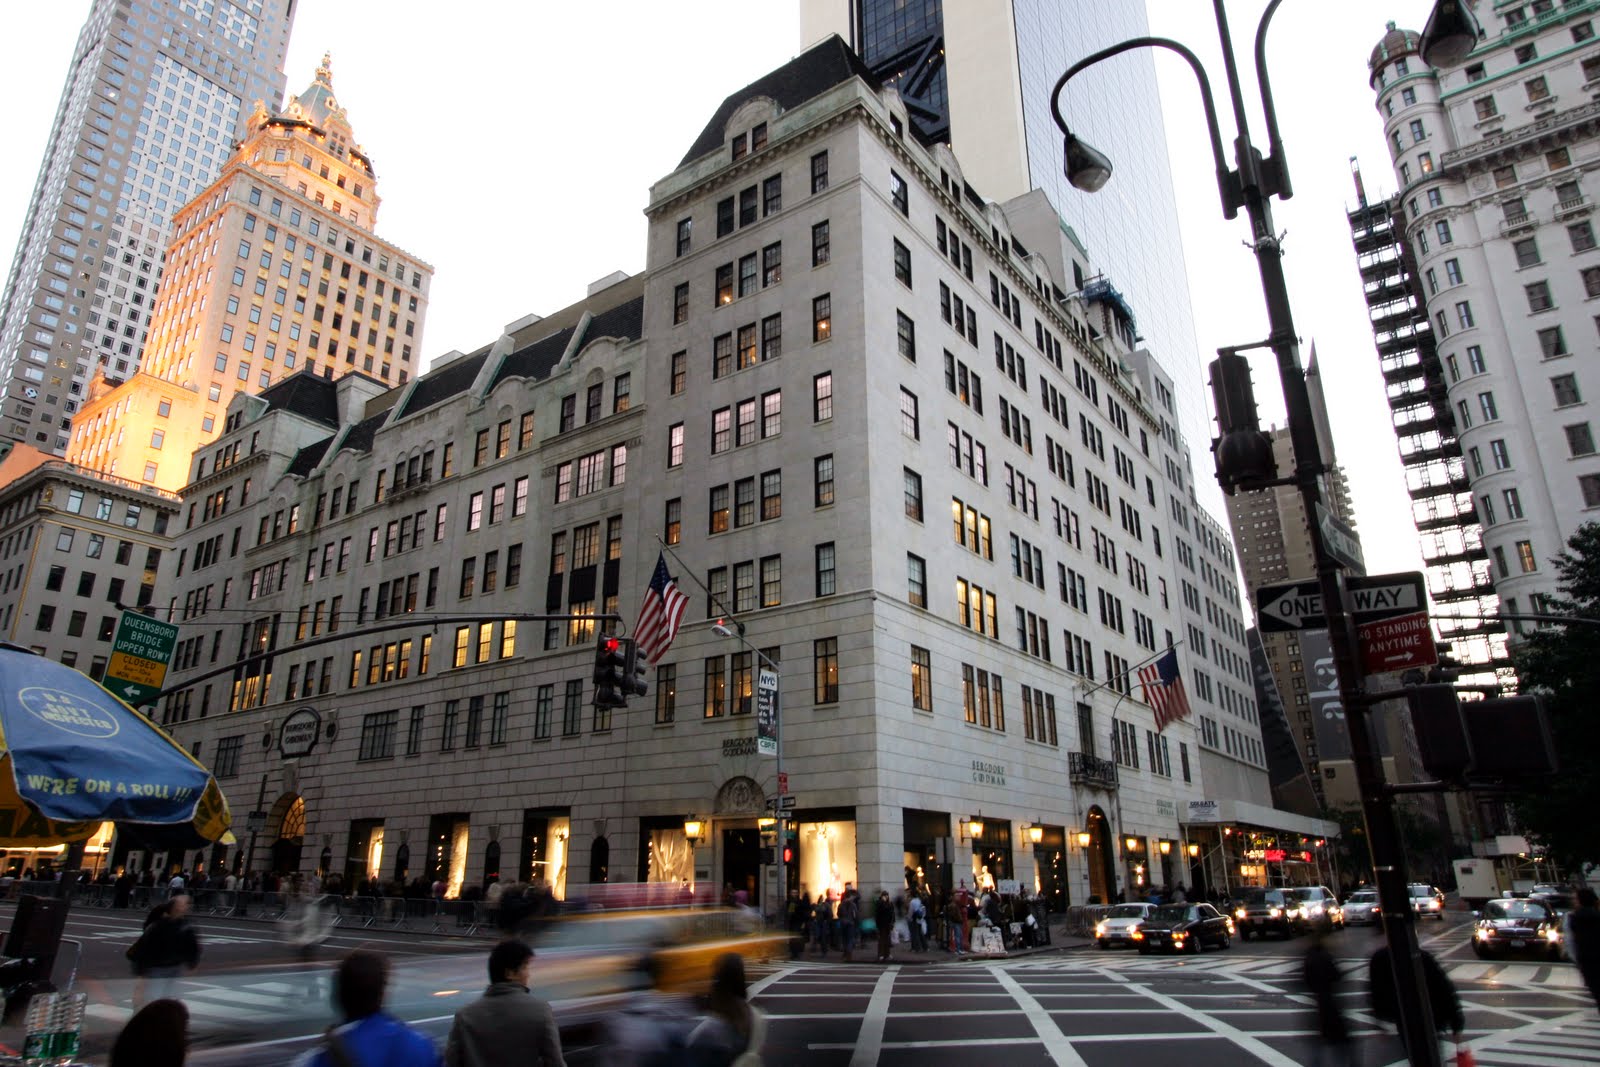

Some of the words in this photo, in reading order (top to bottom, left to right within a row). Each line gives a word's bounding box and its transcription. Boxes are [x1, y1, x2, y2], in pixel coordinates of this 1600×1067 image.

[1279, 597, 1322, 617] ONE
[1354, 588, 1402, 610] WAY
[124, 616, 175, 639] QUEENSBORO
[1376, 618, 1426, 638] STANDING
[130, 631, 163, 648] BRIDGE
[1369, 634, 1421, 654] ANYTIME
[116, 640, 145, 655] UPPER
[146, 648, 170, 661] RDWY
[123, 656, 156, 670] CLOSED
[760, 675, 775, 687] NYC
[722, 736, 758, 748] BERGDORF
[972, 760, 1005, 775] BERGDORF
[972, 772, 1006, 786] GOODMAN
[85, 779, 111, 793] ON
[116, 782, 127, 794] A
[131, 784, 169, 800] ROLL
